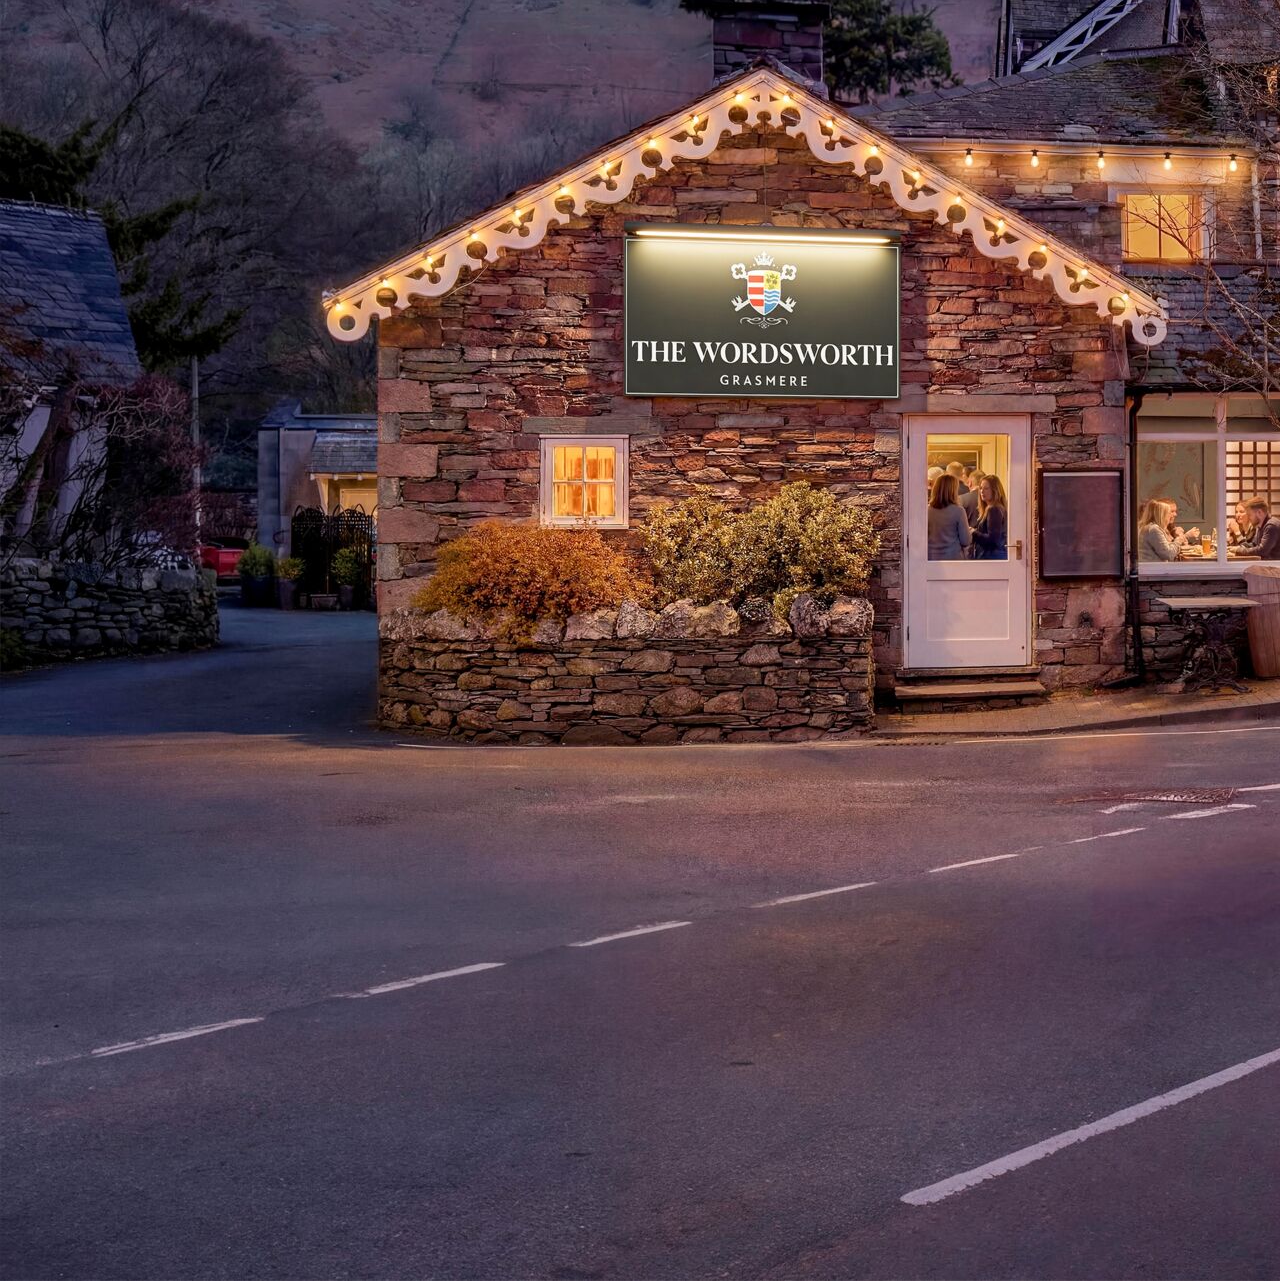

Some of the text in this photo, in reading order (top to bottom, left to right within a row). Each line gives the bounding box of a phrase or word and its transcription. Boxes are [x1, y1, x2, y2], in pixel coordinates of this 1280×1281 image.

[631, 340, 893, 366] THE WORDSWORTH
[719, 374, 808, 387] GRASMERE
